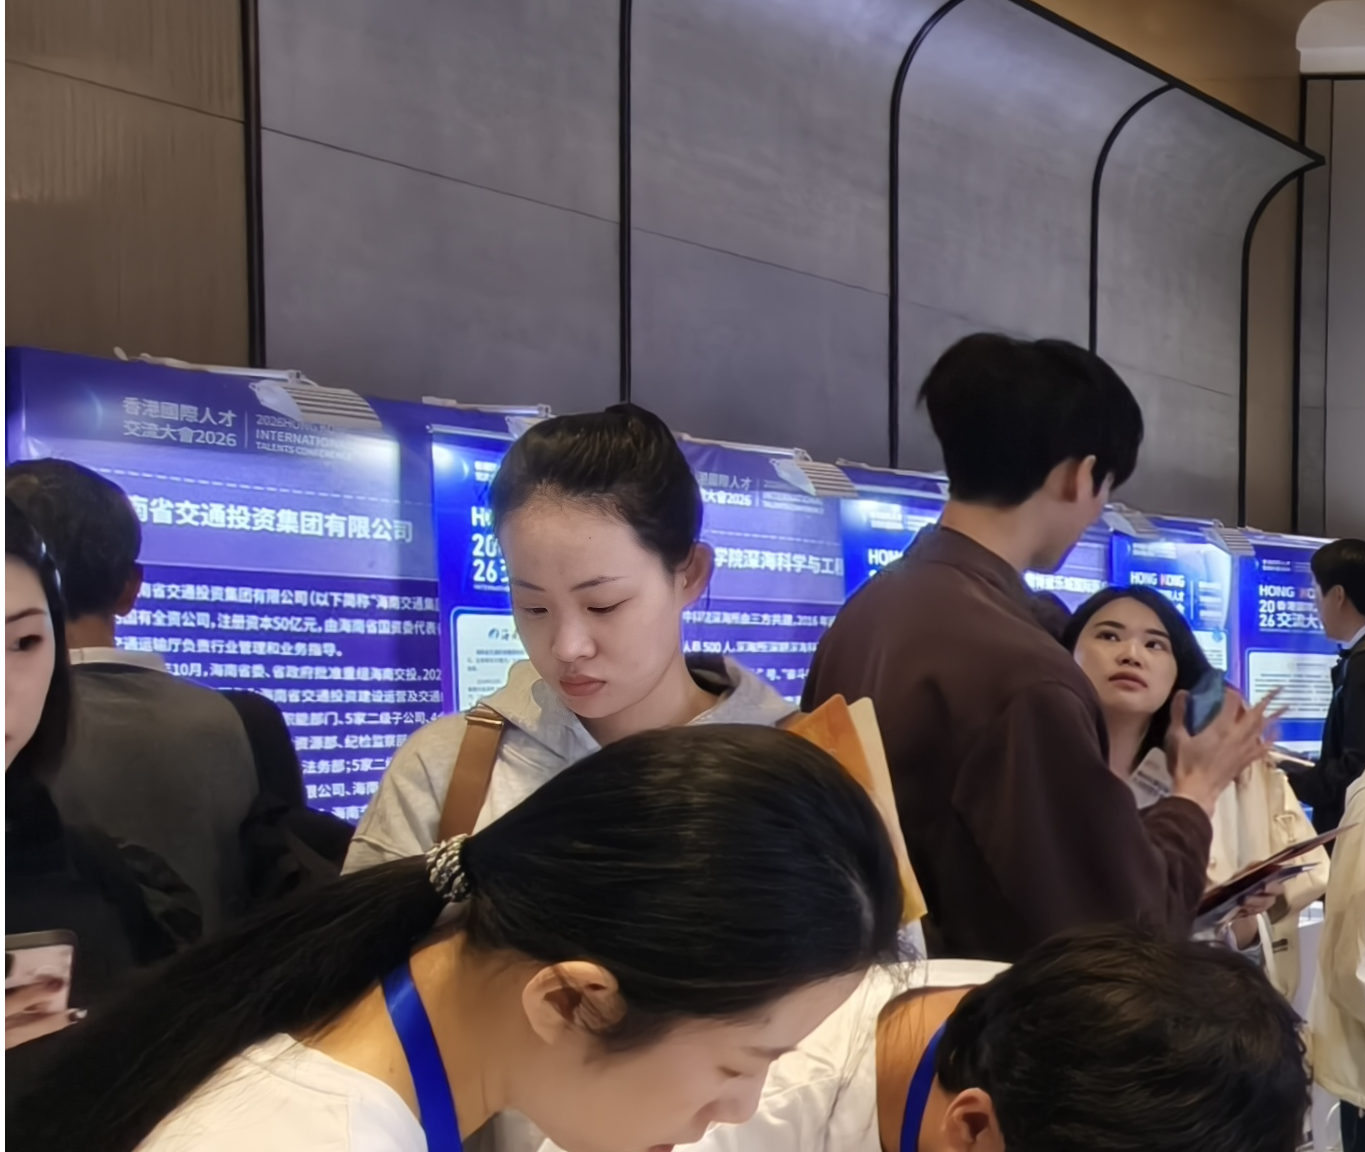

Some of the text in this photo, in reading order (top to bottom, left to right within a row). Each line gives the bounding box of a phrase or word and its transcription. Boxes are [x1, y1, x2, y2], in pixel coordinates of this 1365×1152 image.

[123, 396, 237, 427] 香港國際人才
[123, 420, 237, 447] 交流大會2026
[1130, 571, 1157, 586] HONG
[1259, 585, 1294, 598] HONG
[1259, 600, 1275, 613] 20
[1259, 614, 1275, 627] 26
